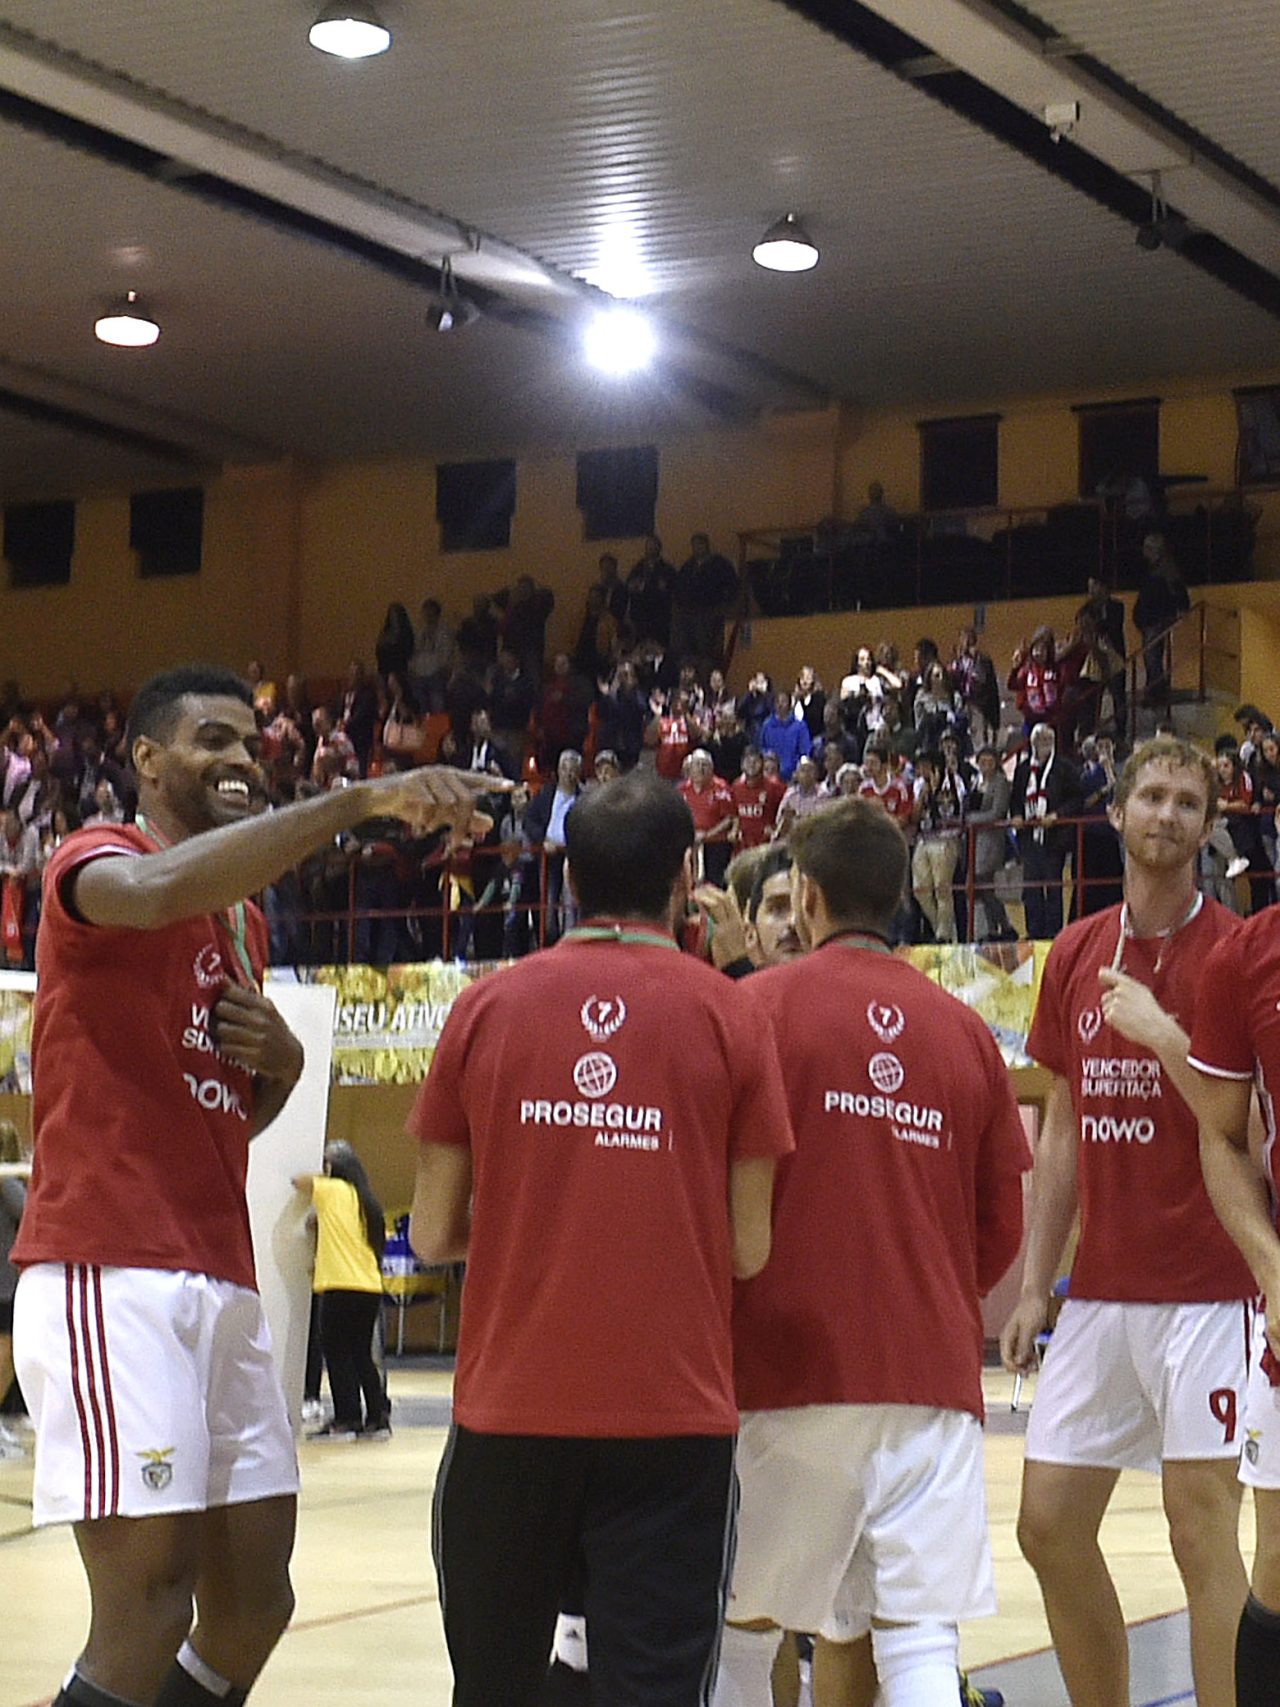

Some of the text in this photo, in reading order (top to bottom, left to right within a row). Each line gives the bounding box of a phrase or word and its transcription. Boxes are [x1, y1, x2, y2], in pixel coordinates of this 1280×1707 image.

[598, 1000, 612, 1022] 7
[879, 1006, 891, 1026] 7
[520, 1099, 661, 1131] PROSEGUR
[824, 1090, 943, 1131] PROSEGUR
[594, 1131, 660, 1151] ALARMES
[1081, 1114, 1155, 1144] nowo
[1208, 1388, 1236, 1445] 9
